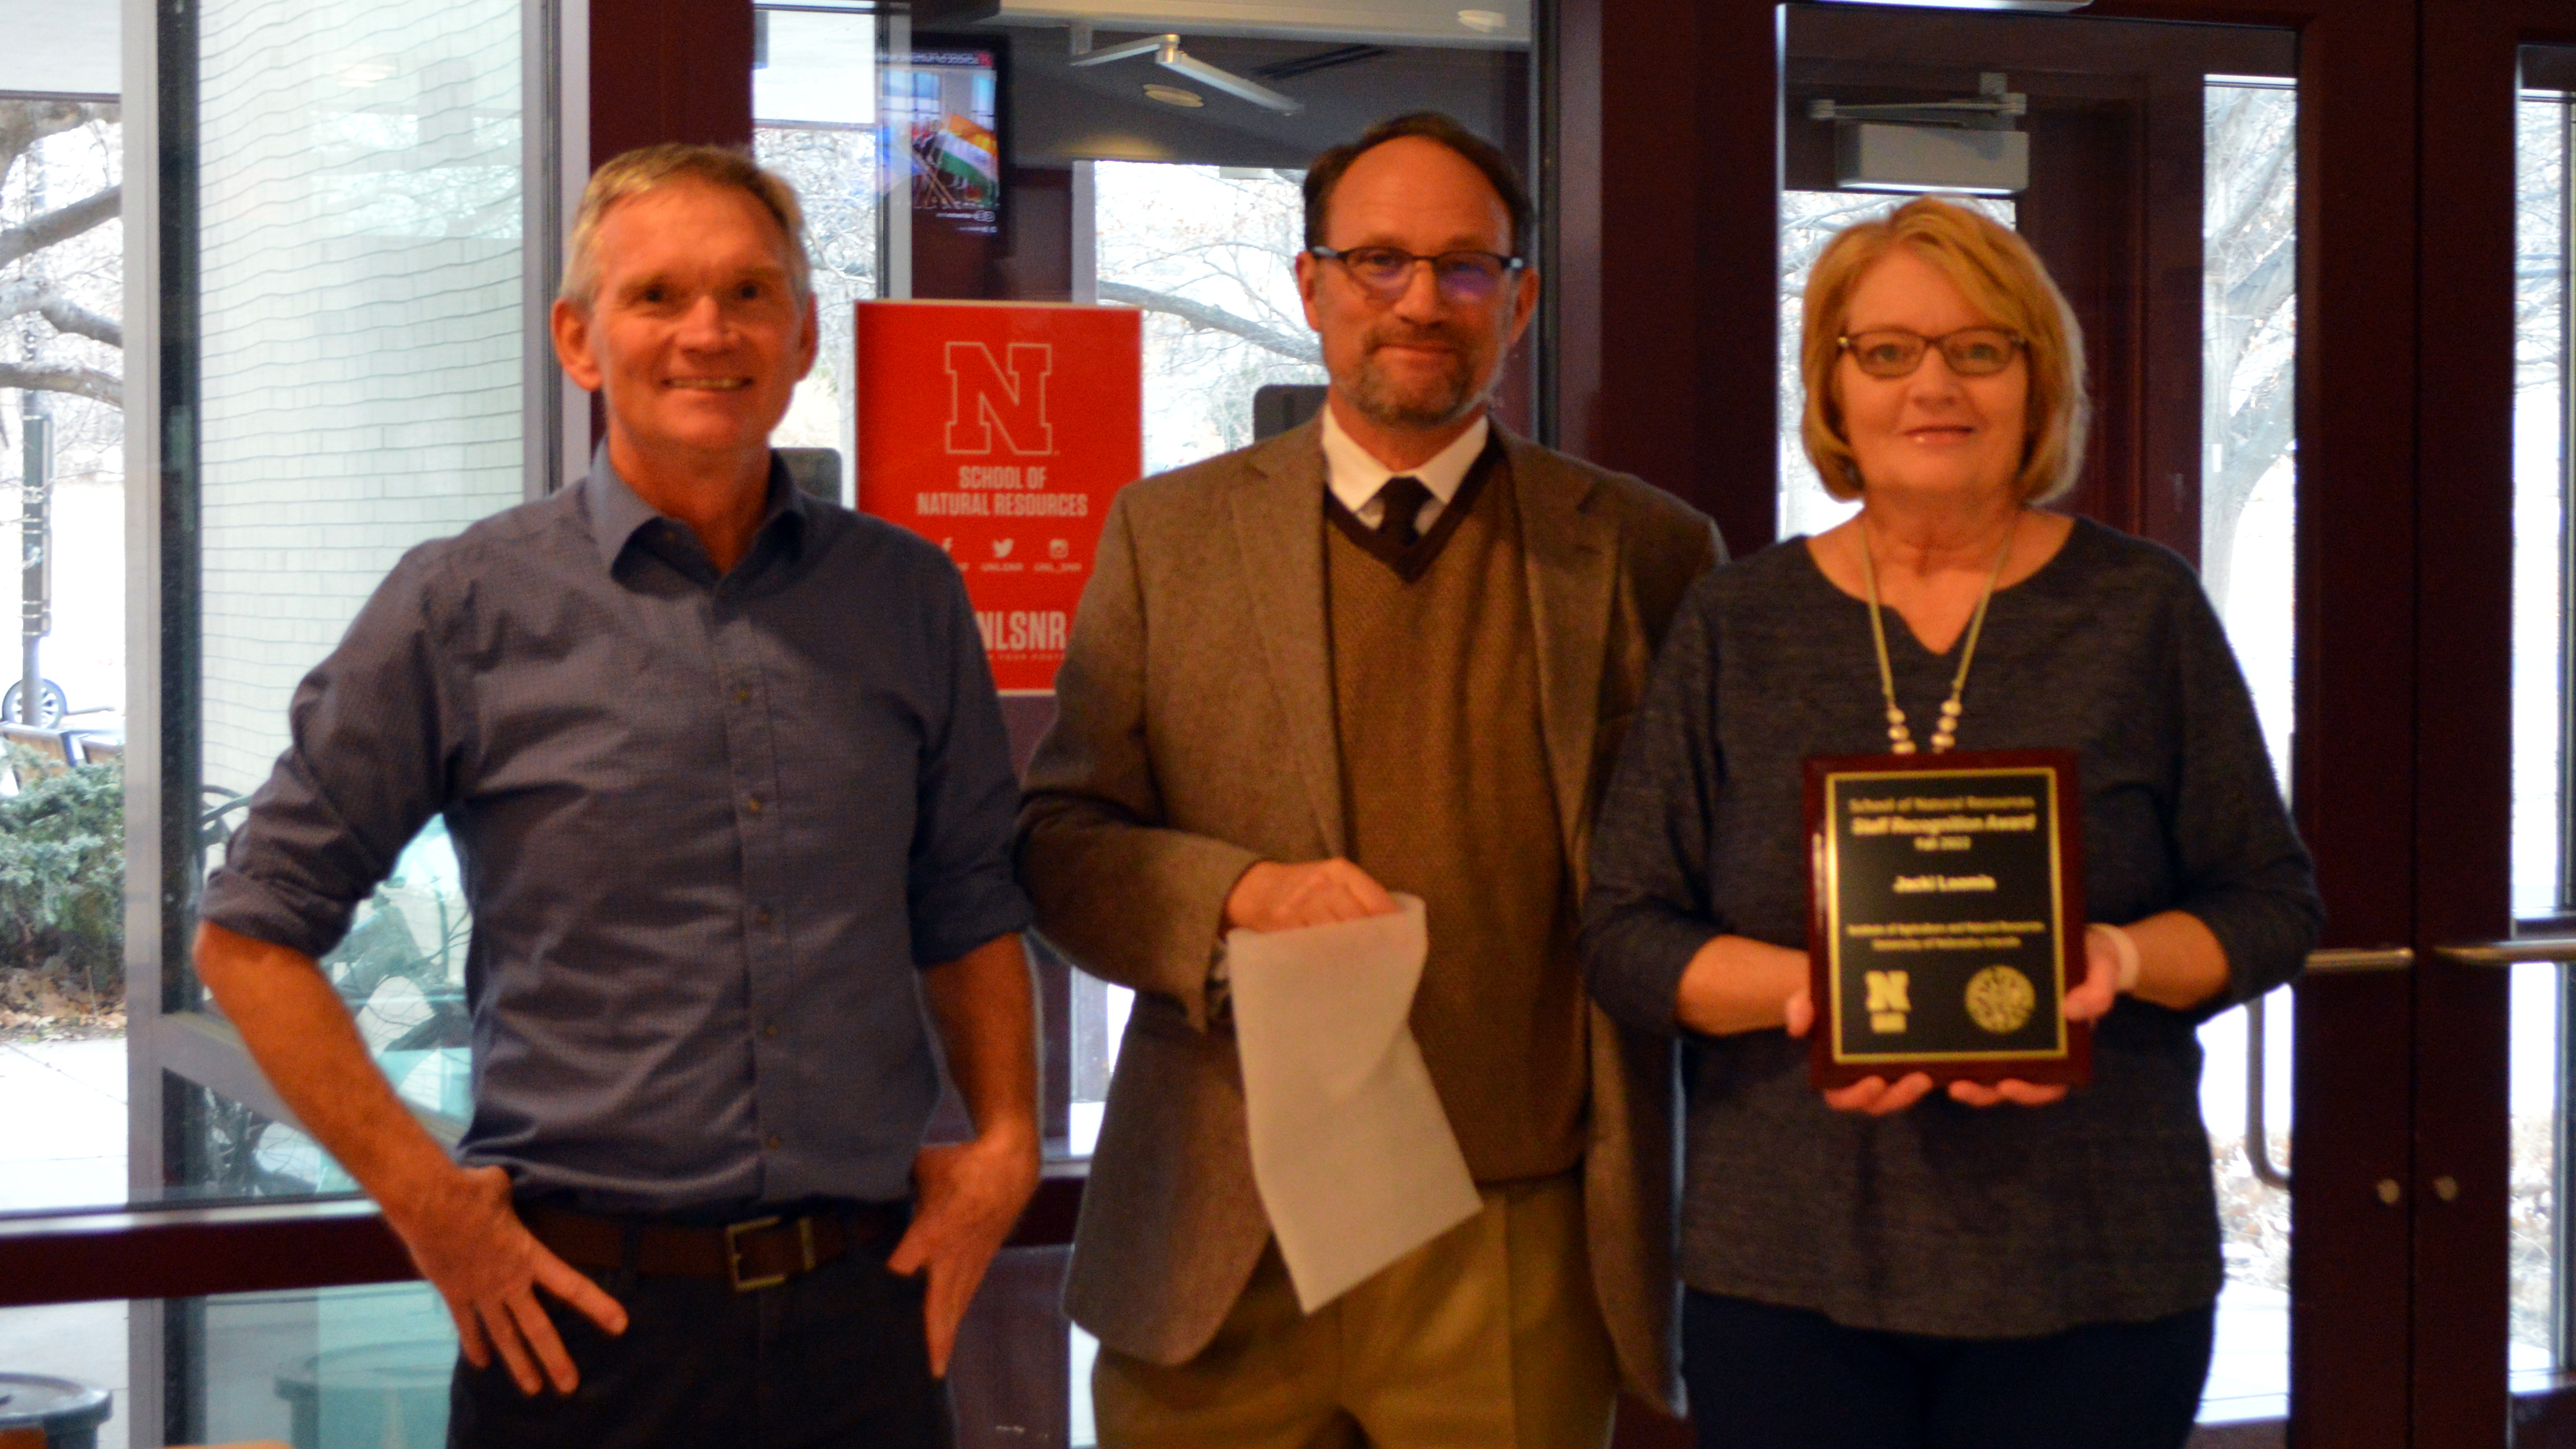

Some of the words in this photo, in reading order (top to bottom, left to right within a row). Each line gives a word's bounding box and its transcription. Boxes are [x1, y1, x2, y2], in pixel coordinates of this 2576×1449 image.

[945, 342, 1053, 455] N
[959, 466, 1022, 489] SCHOOL
[1026, 467, 1047, 489] OF
[918, 492, 989, 516] NATURAL
[994, 493, 1087, 516] RESOURCES
